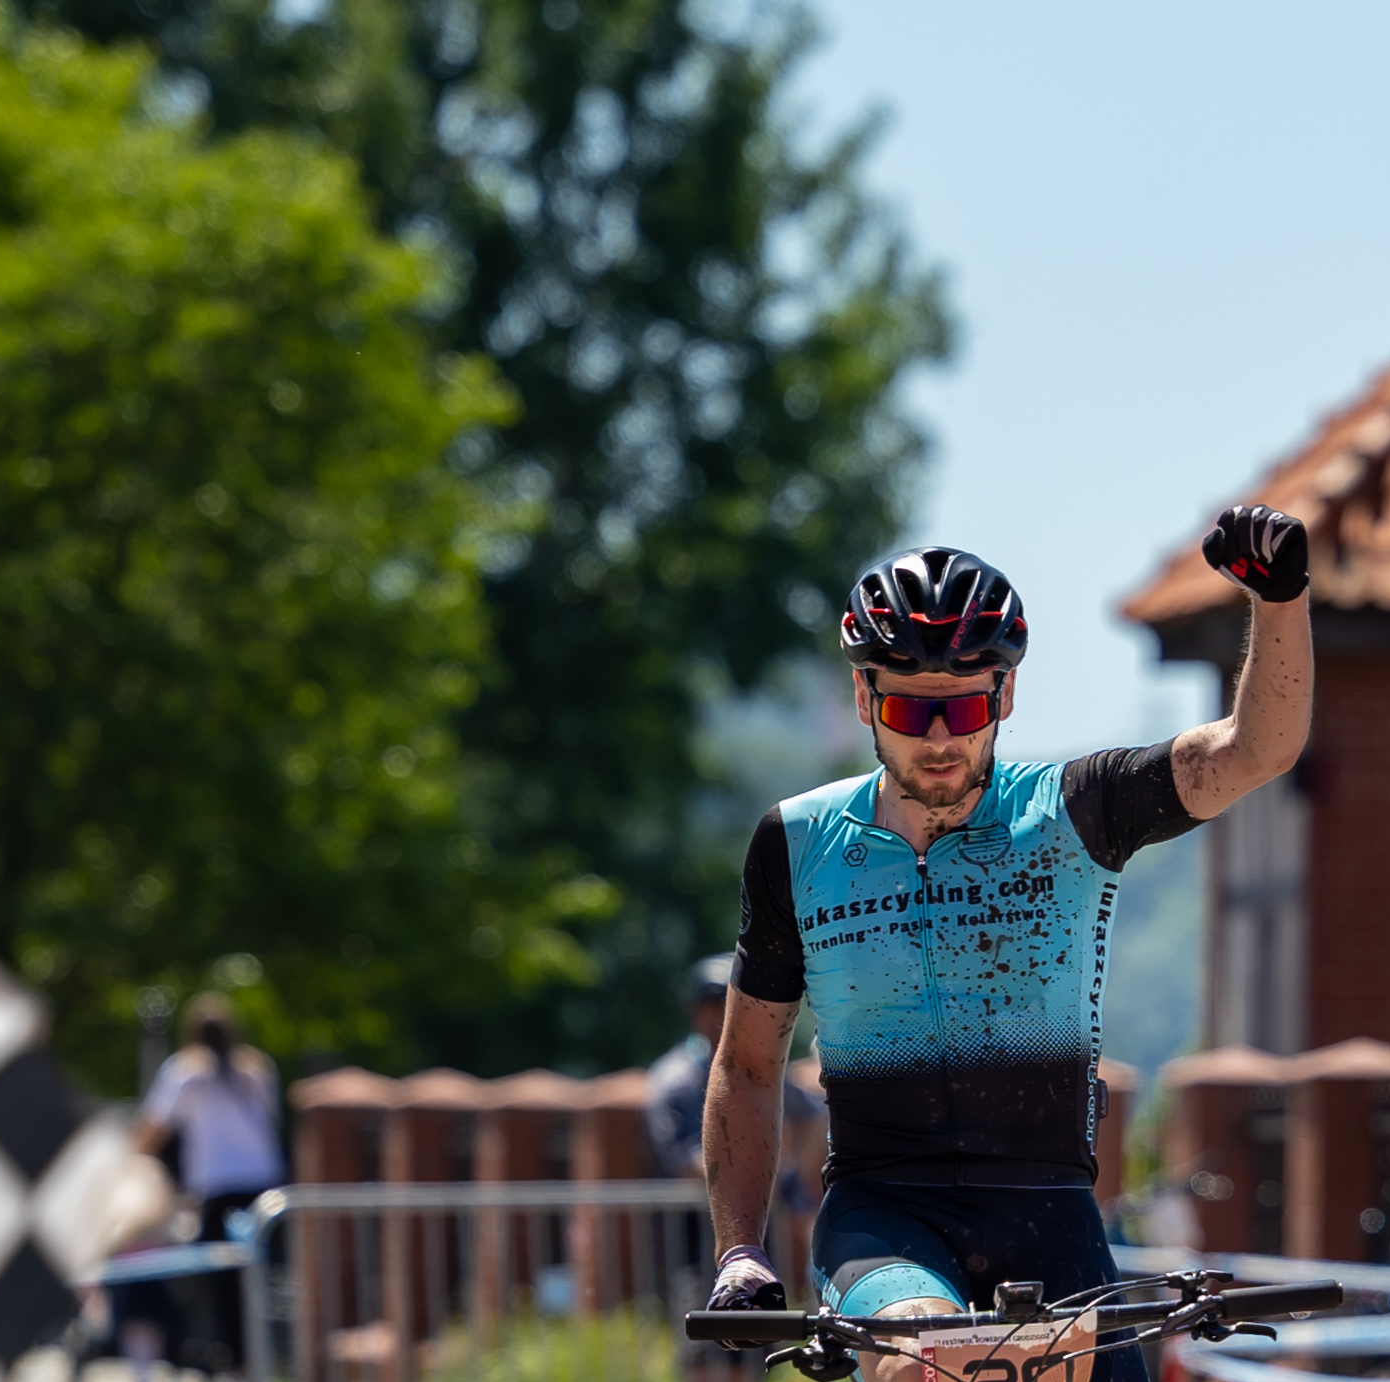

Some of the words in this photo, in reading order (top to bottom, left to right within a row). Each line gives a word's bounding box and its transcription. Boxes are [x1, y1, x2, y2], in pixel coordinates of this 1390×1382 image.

[808, 929, 867, 954] Trening
[889, 916, 934, 935] Pasja
[957, 908, 1045, 927] Kolarstwo
